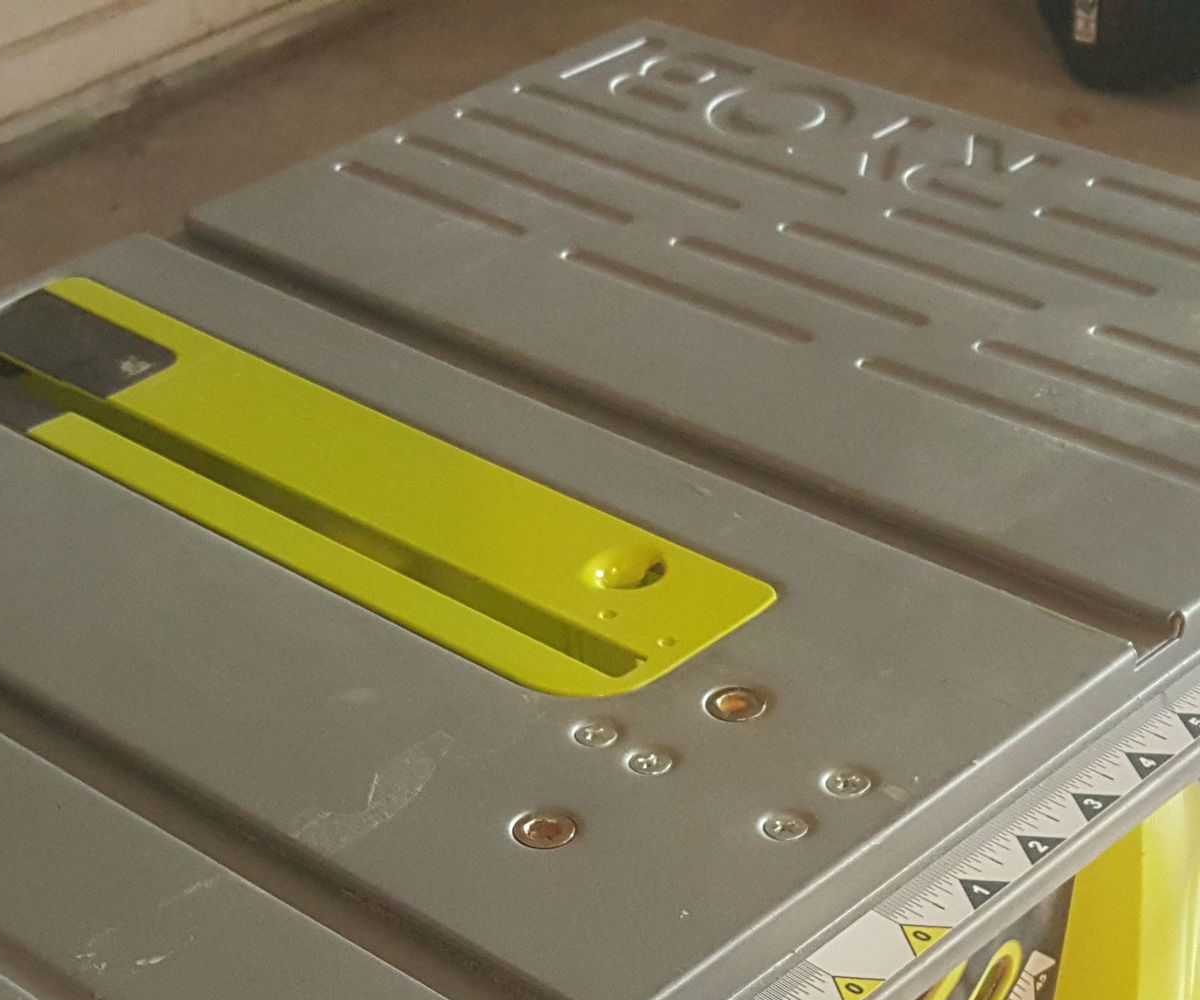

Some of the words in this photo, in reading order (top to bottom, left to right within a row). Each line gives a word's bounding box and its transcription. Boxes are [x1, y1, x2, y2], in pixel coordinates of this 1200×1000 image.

[912, 930, 932, 942] 0
[972, 884, 990, 896] 1
[1028, 840, 1049, 854] 2
[1083, 798, 1103, 810] 3
[1138, 756, 1157, 768] 4
[844, 982, 865, 995] 0
